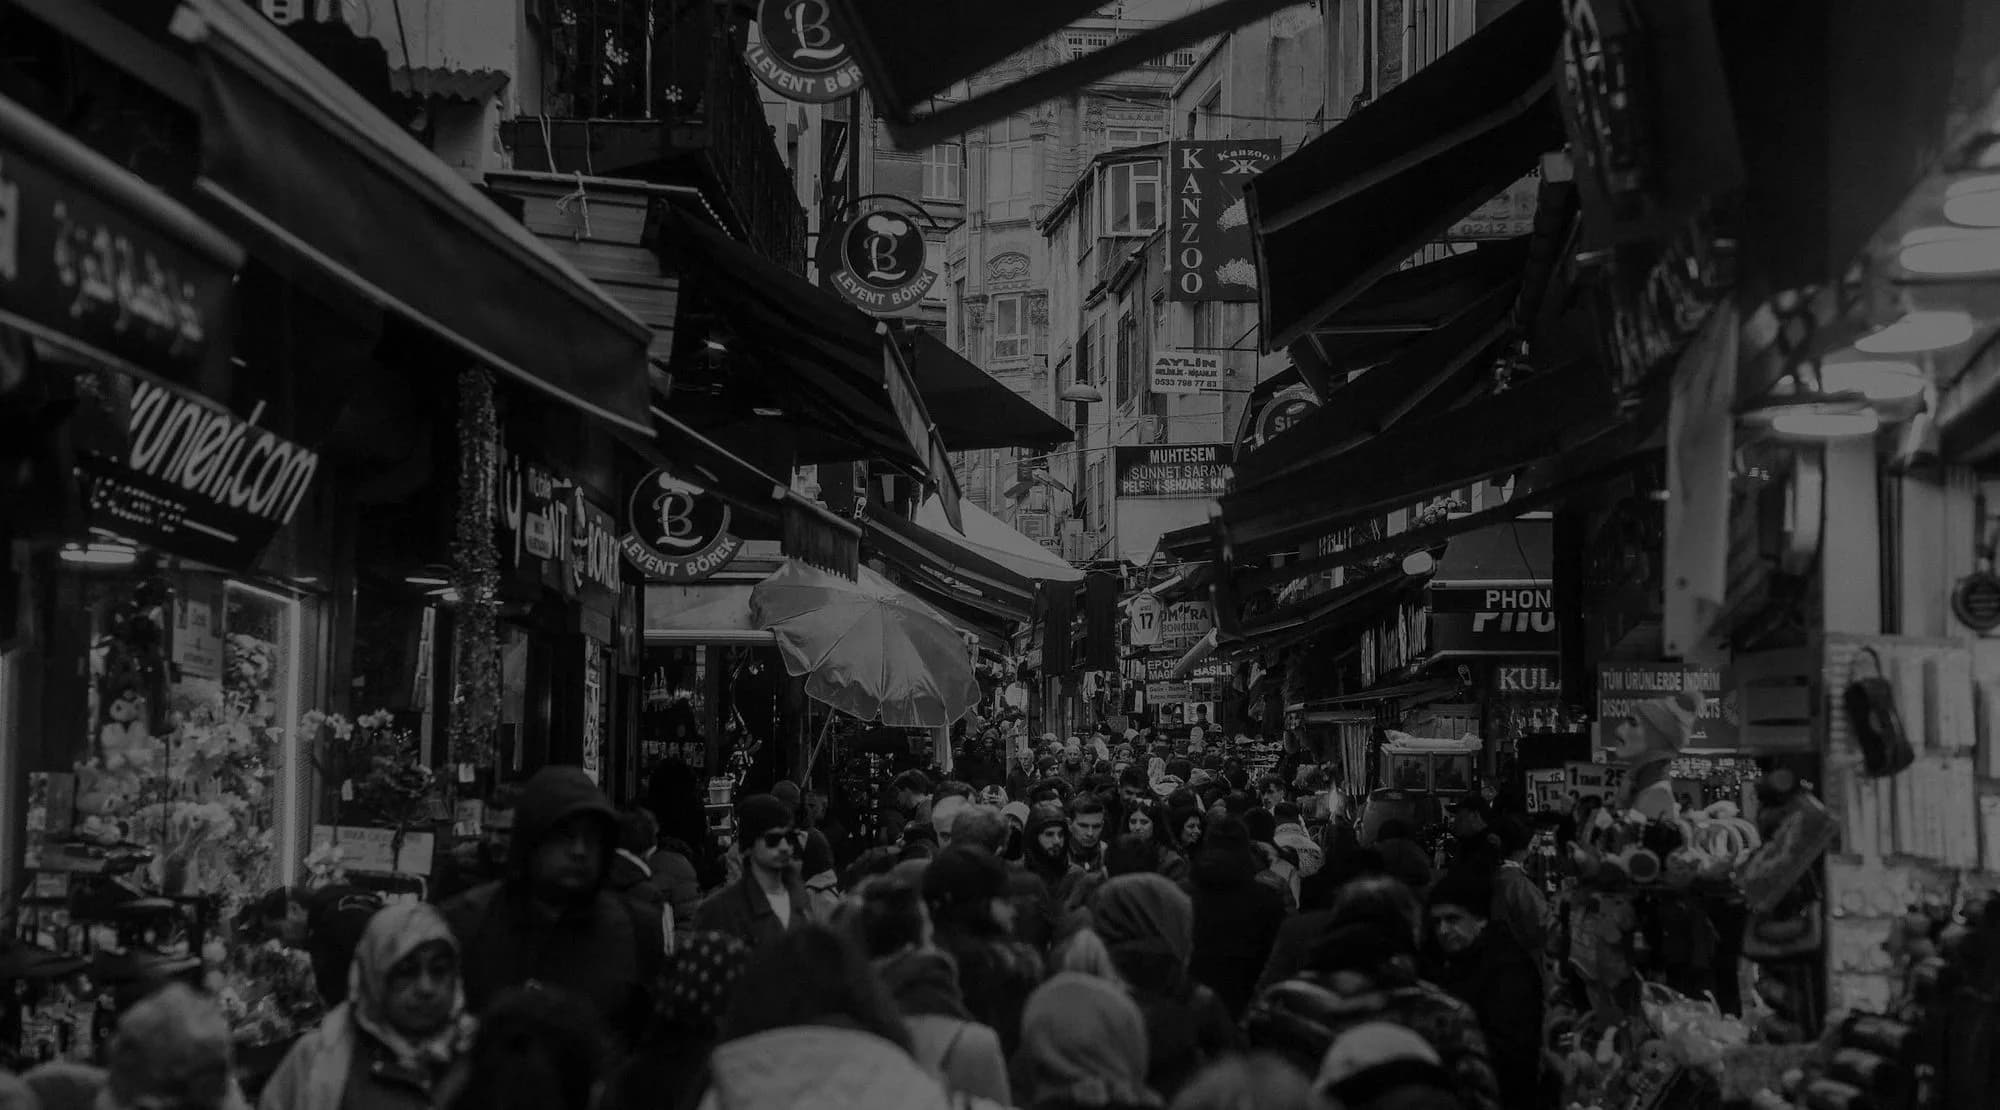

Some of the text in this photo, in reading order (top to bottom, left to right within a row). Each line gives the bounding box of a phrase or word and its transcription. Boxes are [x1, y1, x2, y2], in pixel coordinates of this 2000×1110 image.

[749, 48, 816, 94] LEVENT
[1216, 149, 1270, 161] Kanzoo
[1180, 148, 1204, 294] KANZOO
[836, 271, 934, 305] LEVENT BÖREK
[1155, 378, 1175, 386] 0533
[1131, 464, 1181, 480] SÜNNET
[622, 535, 737, 577] LEVENT BÖREK
[1139, 612, 1154, 630] 17
[1498, 667, 1561, 690] KUL
[1602, 667, 1623, 691] TÜM
[1568, 766, 1578, 786] 1
